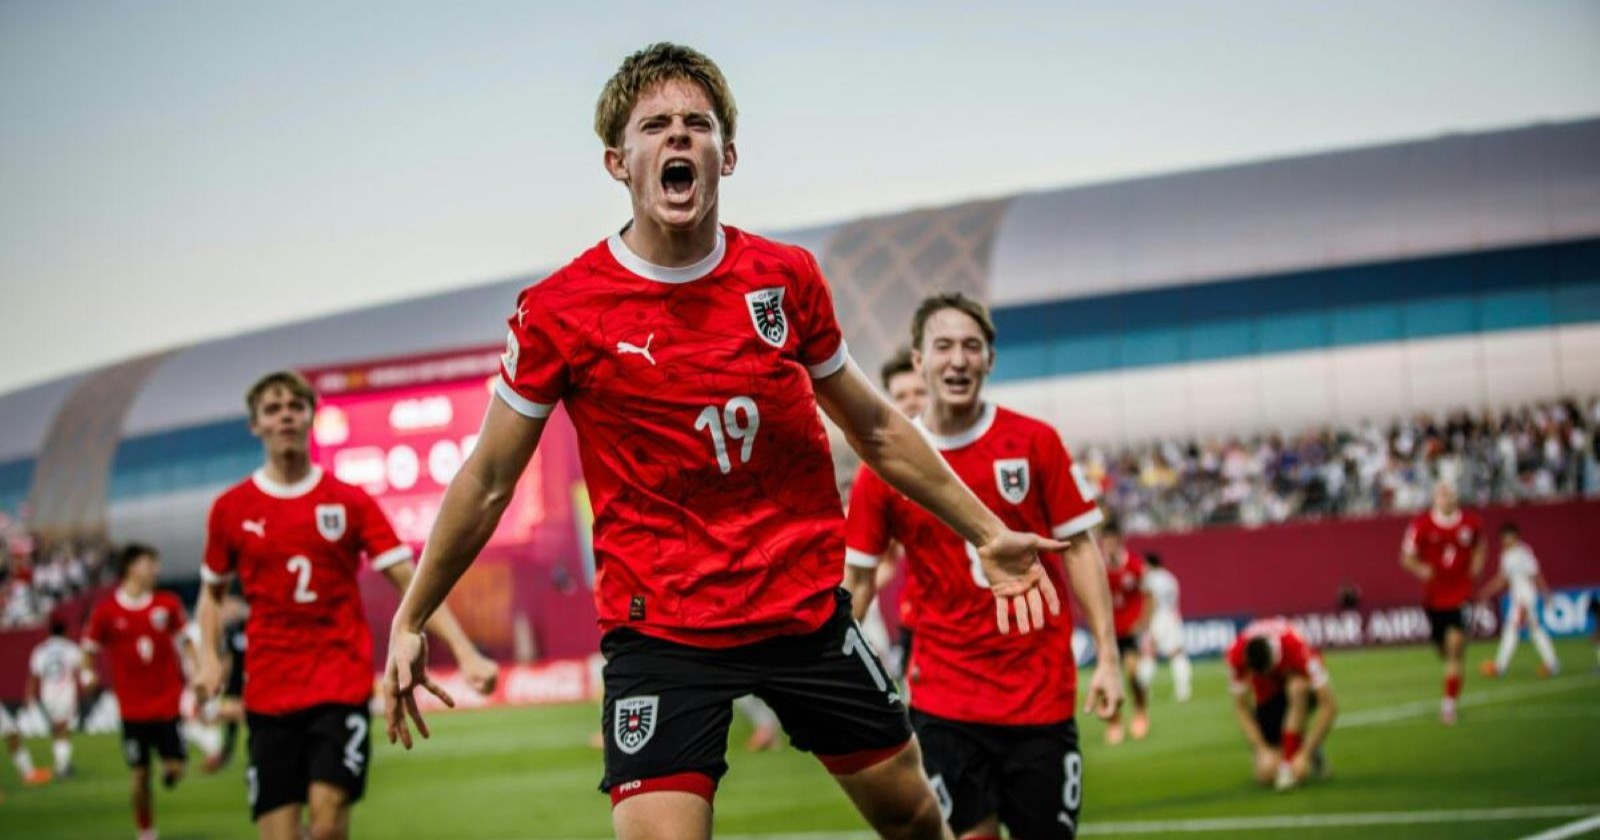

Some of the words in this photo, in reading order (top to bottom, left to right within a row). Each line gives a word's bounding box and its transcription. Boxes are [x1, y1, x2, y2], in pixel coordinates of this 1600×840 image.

[694, 396, 759, 475] 19
[286, 555, 317, 603] 2
[842, 617, 887, 692] 1
[344, 714, 367, 763] 2
[619, 779, 642, 794] PRO
[1063, 752, 1082, 810] 8
